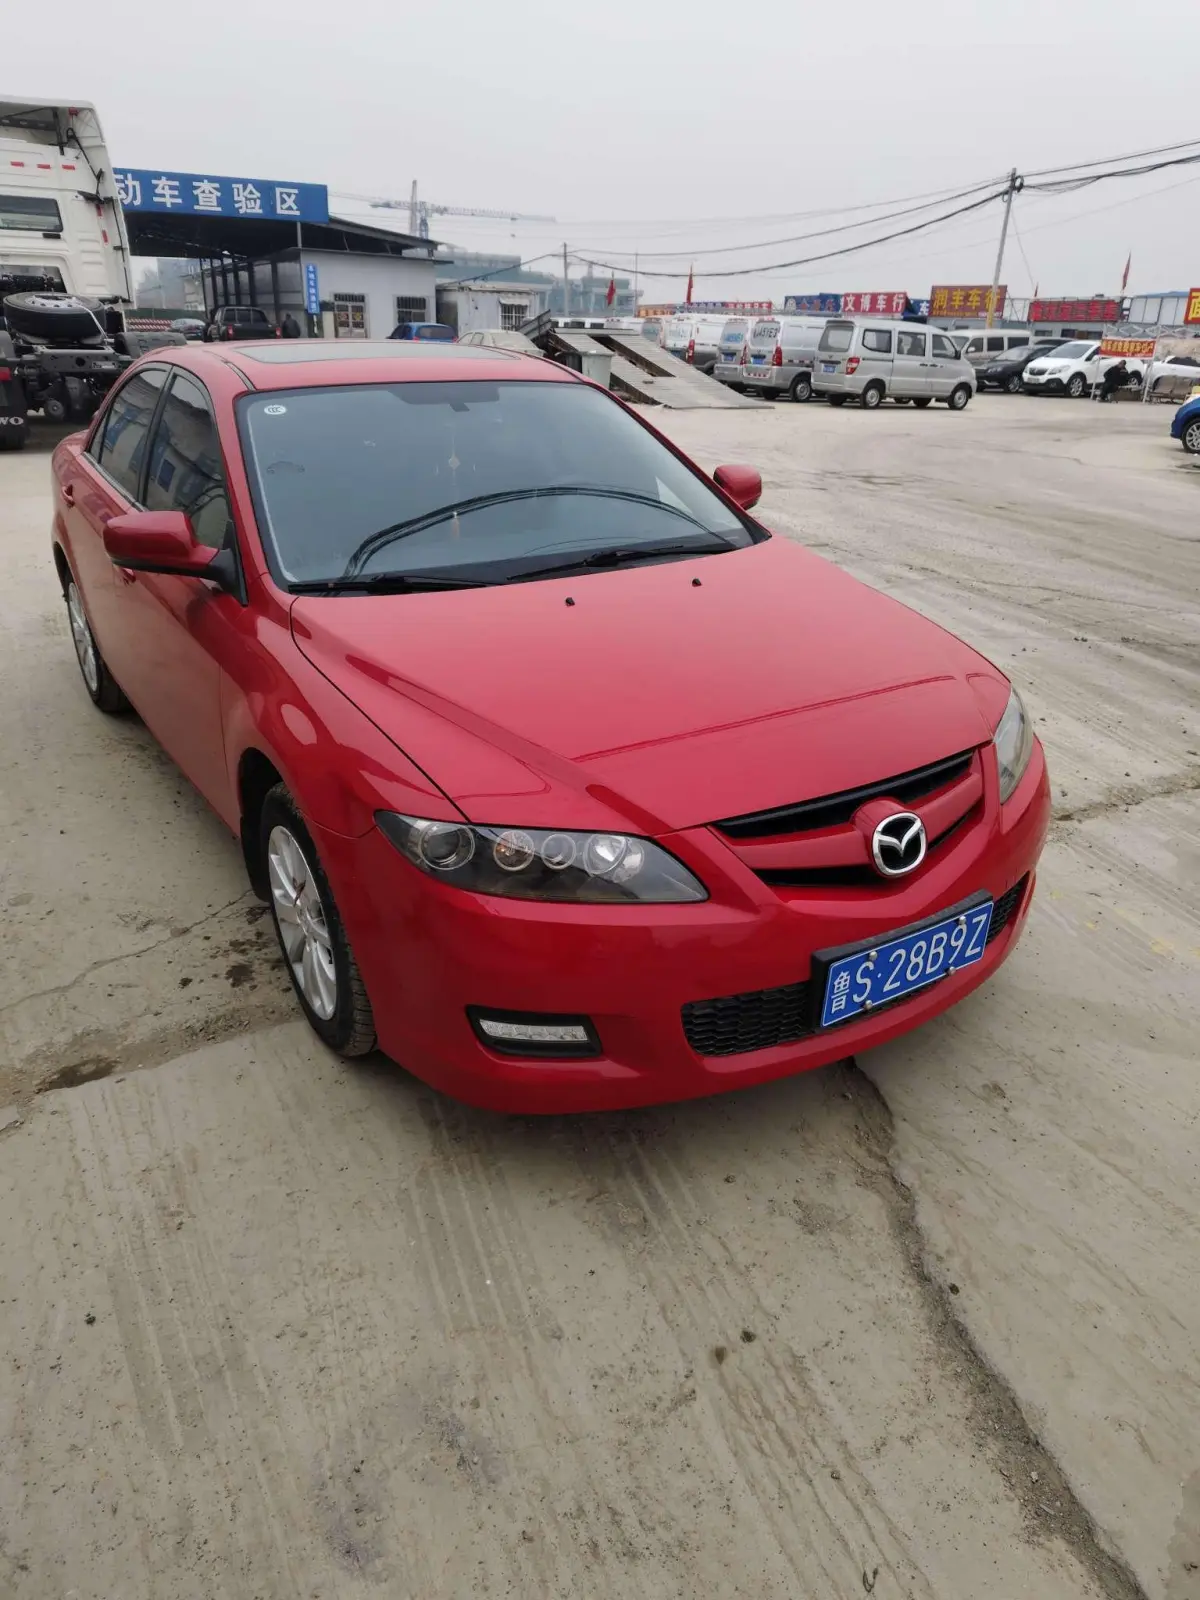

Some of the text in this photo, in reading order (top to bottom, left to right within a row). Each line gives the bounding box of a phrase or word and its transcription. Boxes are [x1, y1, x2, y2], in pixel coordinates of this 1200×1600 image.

[113, 173, 301, 216] 动车查验区
[845, 293, 905, 313] 文博车行
